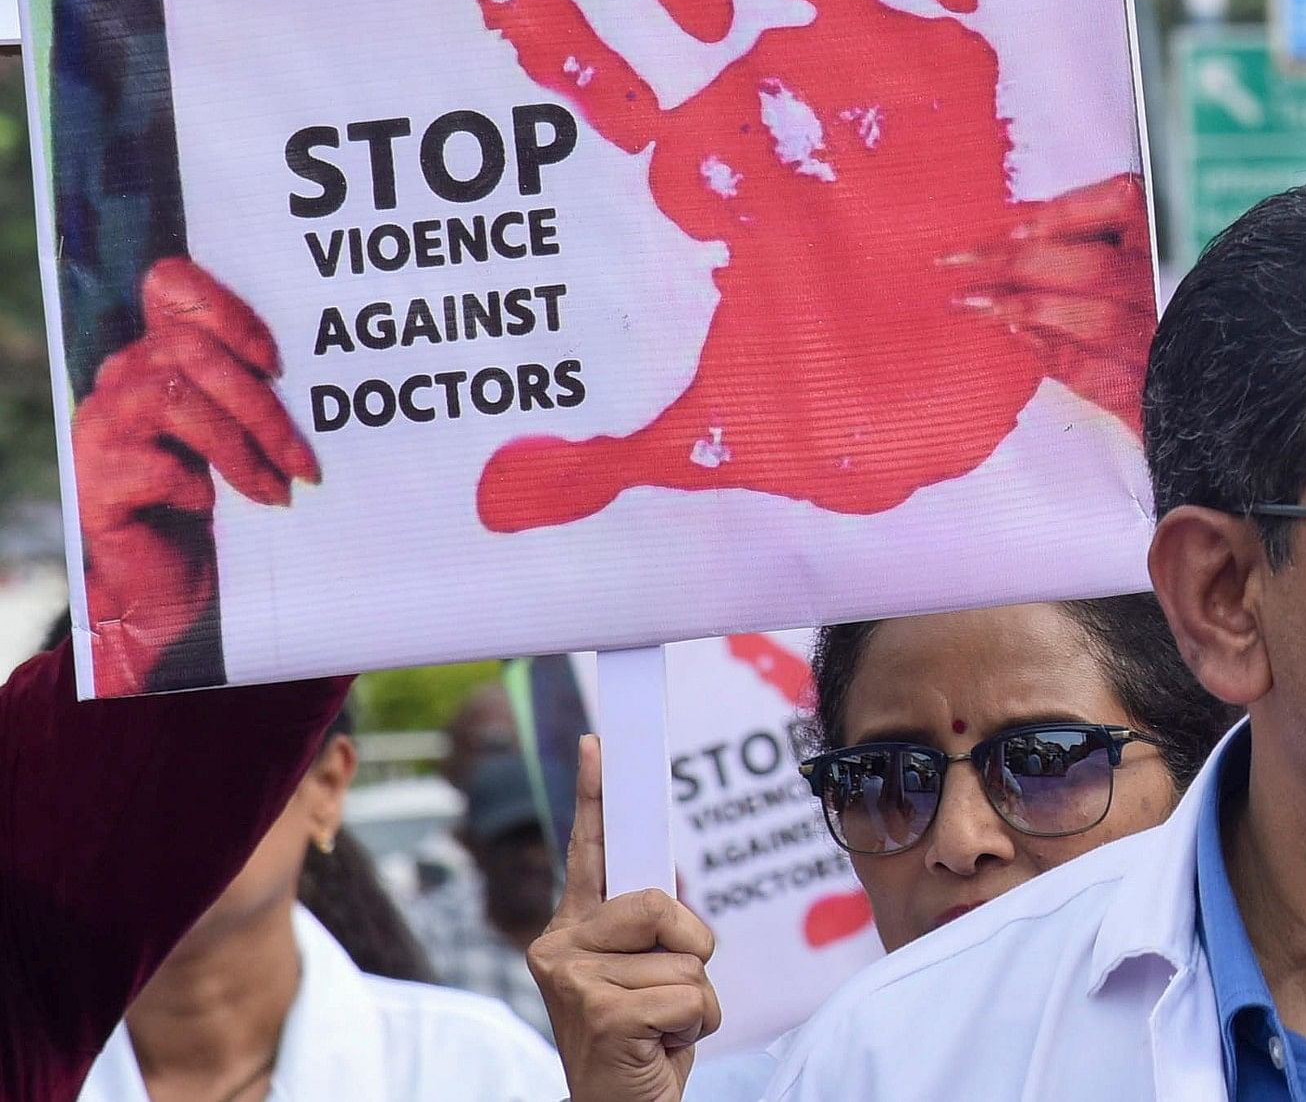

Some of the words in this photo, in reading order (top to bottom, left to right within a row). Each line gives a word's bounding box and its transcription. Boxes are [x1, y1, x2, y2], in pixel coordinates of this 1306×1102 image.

[285, 103, 578, 219] STOP
[305, 208, 560, 278] VIOENCE
[313, 284, 567, 356] AGAINST
[310, 360, 587, 433] DOCTORS
